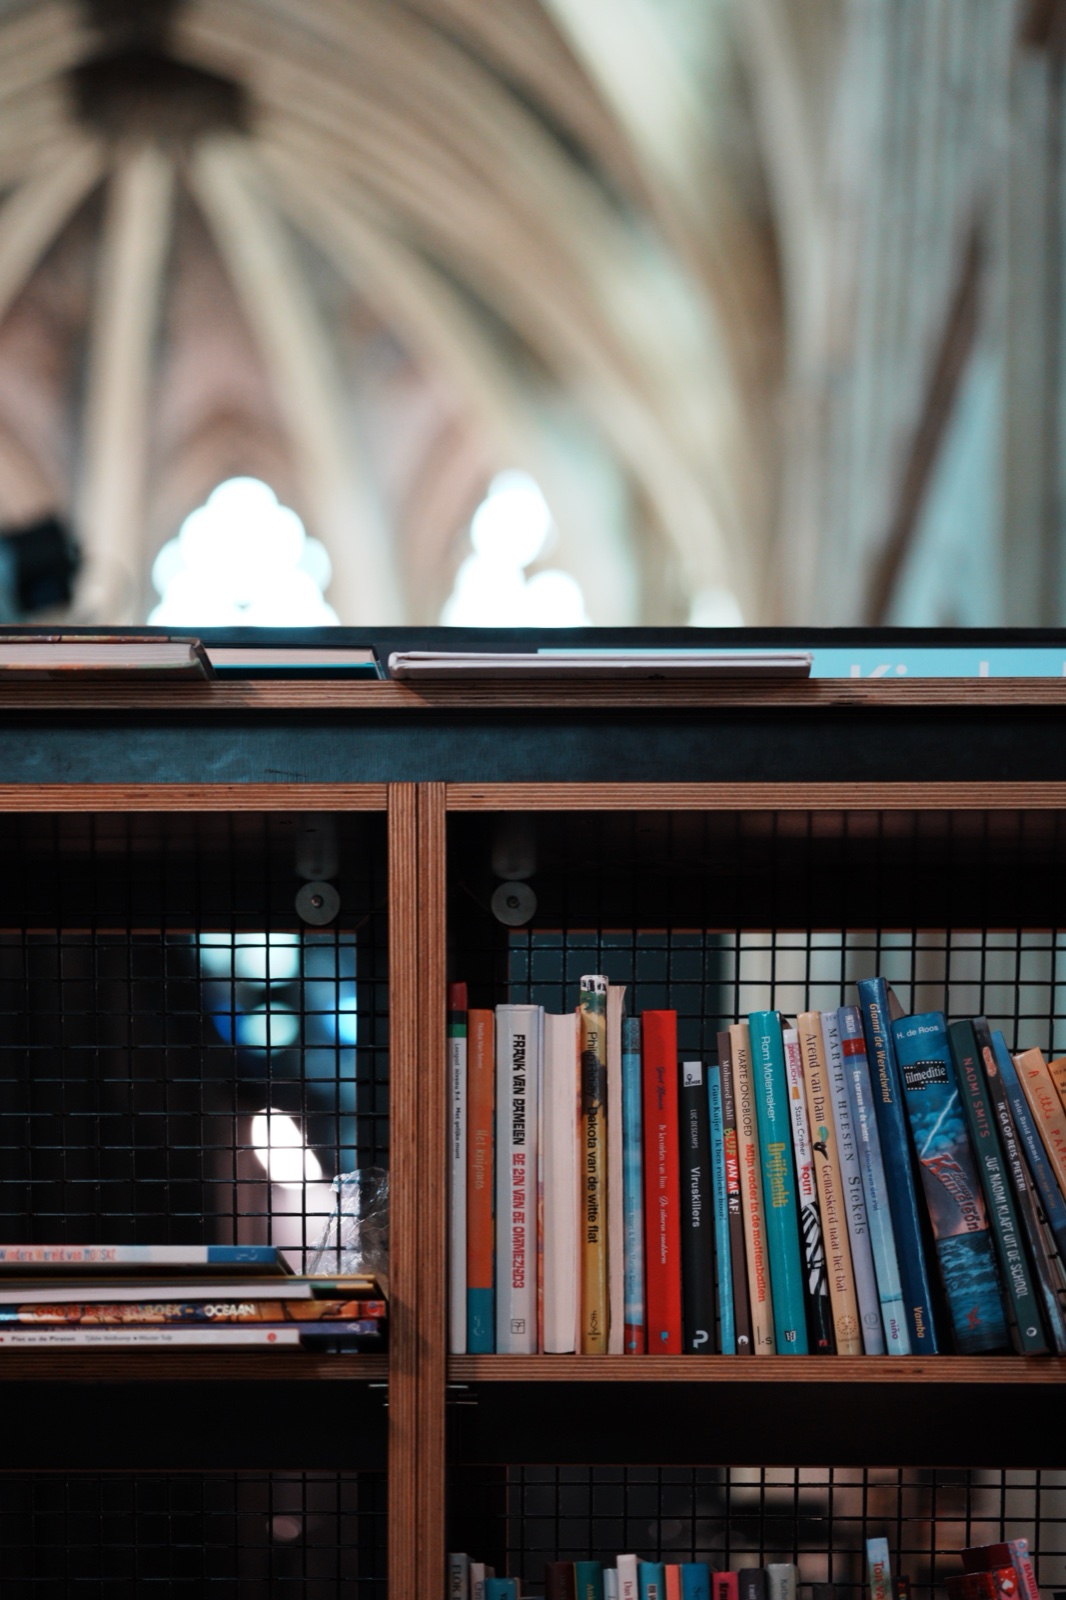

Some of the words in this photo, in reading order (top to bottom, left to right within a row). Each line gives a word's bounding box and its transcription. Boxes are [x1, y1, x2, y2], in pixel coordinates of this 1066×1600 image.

[869, 1003, 881, 1033] Gianni
[874, 1036, 883, 1047] de
[906, 1029, 917, 1037] de
[918, 1025, 939, 1034] Roos
[513, 1034, 526, 1071] FRANK
[761, 1035, 771, 1060] Rom
[805, 1033, 820, 1068] Arend
[737, 1049, 748, 1079] MARTE
[787, 1044, 798, 1085] ZOEKLICHT
[905, 1066, 946, 1084] filmeditie
[1028, 1070, 1040, 1078] A
[513, 1075, 525, 1095] VAN
[722, 1060, 731, 1098] Mohamed
[810, 1072, 821, 1093] van
[853, 1070, 861, 1082] Een
[876, 1050, 892, 1103] Wervelwind
[711, 1084, 719, 1105] Guus
[763, 1063, 776, 1121] Molemaker
[829, 1028, 844, 1094] MARTHA
[838, 1101, 854, 1161] HEESEN
[854, 1083, 863, 1106] caravan
[963, 1057, 979, 1096] NAOMI
[973, 1100, 990, 1137] SMITS
[690, 1109, 698, 1119] LUC
[725, 1100, 734, 1120] Sahli
[740, 1081, 752, 1136] JONGBLOED
[794, 1106, 803, 1126] Stasia
[813, 1096, 825, 1122] Dam
[997, 1102, 1005, 1111] IK
[513, 1098, 525, 1145] PAMELEN
[586, 1107, 598, 1149] Dakota
[711, 1107, 721, 1132] Kuijer
[859, 1114, 868, 1122] de
[1000, 1112, 1008, 1124] GA
[476, 1130, 488, 1145] Het
[690, 1120, 699, 1148] DESCAMPS
[797, 1128, 806, 1156] Cramer
[861, 1123, 870, 1142] winter
[1003, 1126, 1013, 1138] OP
[1019, 1116, 1029, 1135] David
[1027, 1135, 1040, 1162] Dommel
[715, 1149, 723, 1164] ben
[745, 1144, 755, 1167] Mijn
[1007, 1140, 1018, 1160] REIS,
[472, 1149, 488, 1189] knipmes
[587, 1151, 596, 1173] van
[726, 1158, 738, 1178] VAN
[985, 1155, 999, 1171] JUF
[587, 1176, 598, 1190] de
[748, 1169, 758, 1200] vader
[766, 1142, 789, 1208] Drijfjacht
[801, 1165, 811, 1196] FOUT!
[1012, 1161, 1026, 1191] PIETER!
[690, 1166, 701, 1227] Viruskillers
[728, 1181, 739, 1194] ME
[822, 1165, 838, 1223] Gemaskerd
[989, 1173, 1006, 1203] NAOMI
[513, 1190, 525, 1209] VAN
[586, 1192, 598, 1222] witte
[729, 1198, 740, 1214] AF!
[750, 1202, 759, 1213] in
[848, 1176, 866, 1234] Stekels
[752, 1214, 761, 1228] de
[996, 1204, 1014, 1232] KLAPT
[586, 1225, 599, 1243] flat
[830, 1227, 840, 1251] naar
[1003, 1233, 1017, 1248] UIT
[753, 1230, 766, 1302] mottenballen
[833, 1255, 843, 1272] het
[1007, 1250, 1020, 1263] DE
[836, 1276, 847, 1292] bal
[1010, 1264, 1029, 1299] SCHOOL
[204, 1304, 256, 1316] OCEAAN
[890, 1319, 899, 1339] niño
[913, 1306, 925, 1338] Vamba
[873, 1561, 884, 1582] Ton
[624, 1581, 633, 1596] Dan
